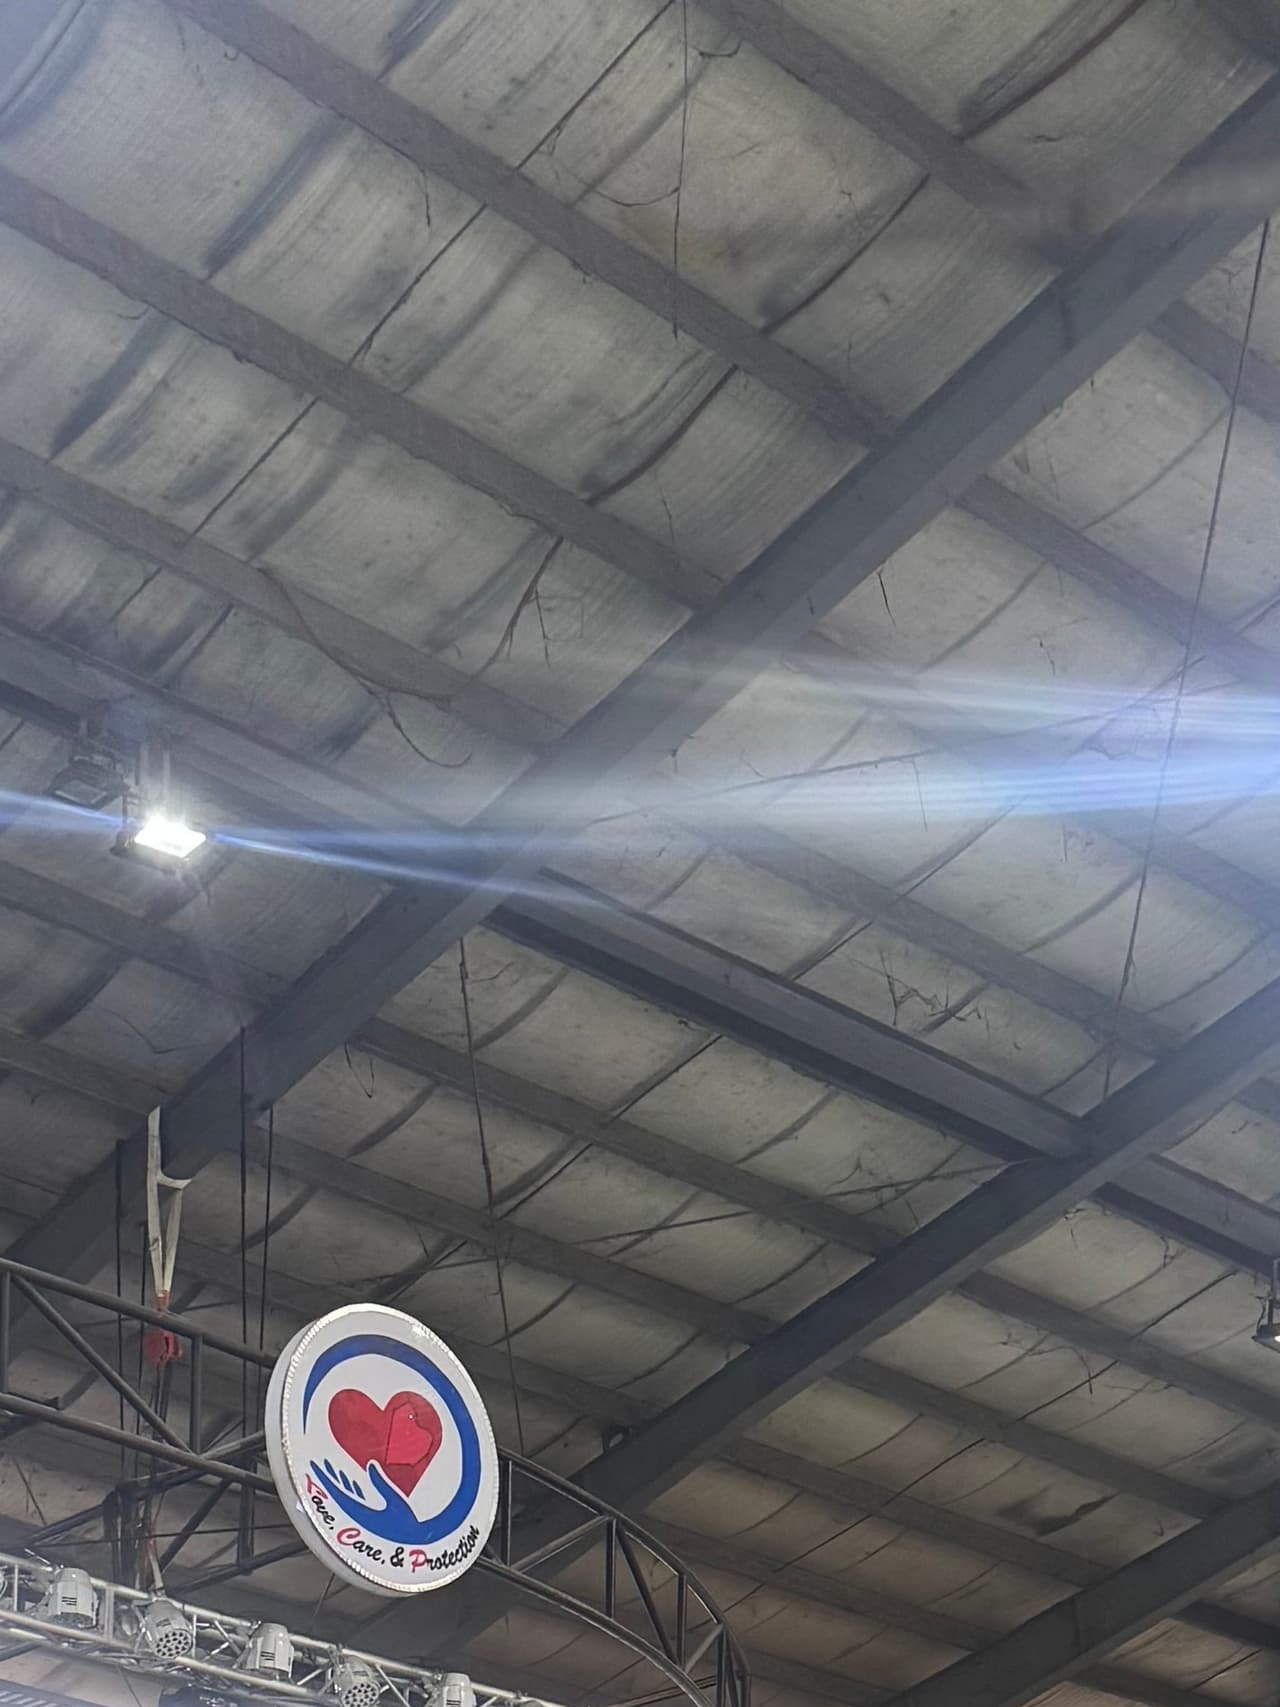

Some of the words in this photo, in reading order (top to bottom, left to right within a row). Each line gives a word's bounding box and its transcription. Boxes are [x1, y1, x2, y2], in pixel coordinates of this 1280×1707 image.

[337, 1527, 385, 1564] Care,
[390, 1547, 405, 1568] &
[409, 1525, 480, 1573] Protection
